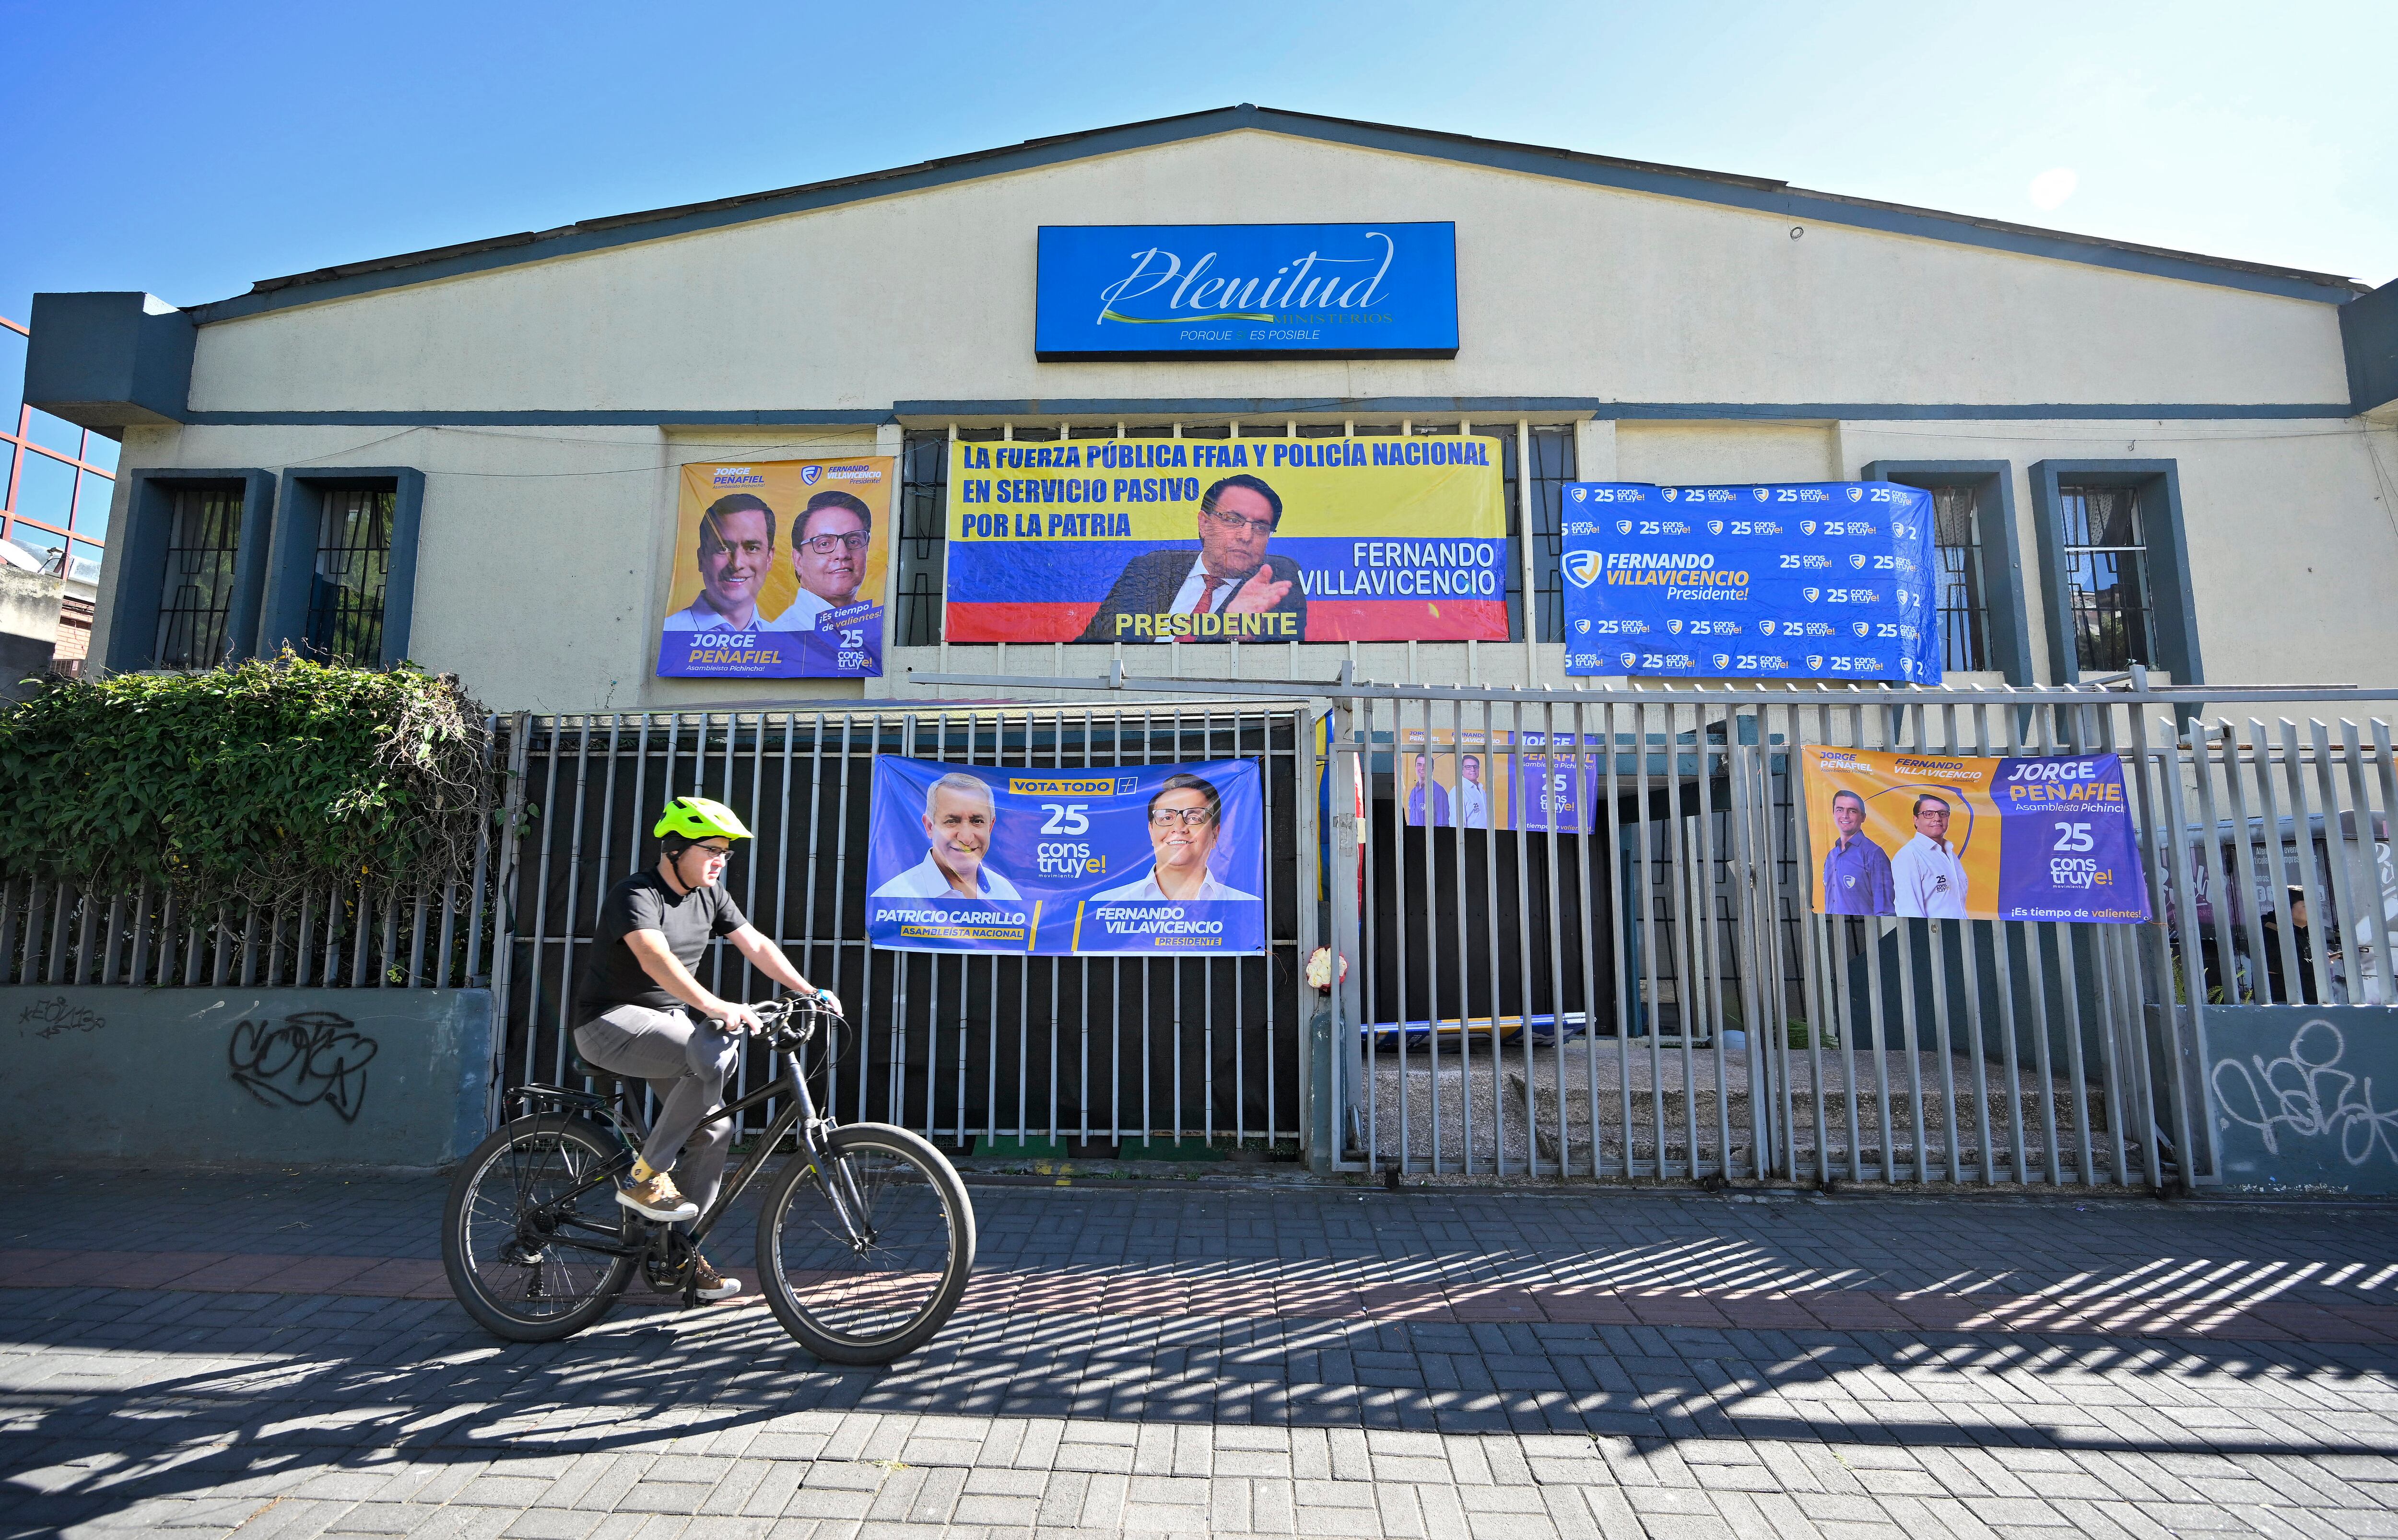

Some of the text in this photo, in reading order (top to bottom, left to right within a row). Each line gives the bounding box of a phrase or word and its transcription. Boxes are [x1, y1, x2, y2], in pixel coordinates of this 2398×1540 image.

[1096, 232, 1394, 325] Plenitud
[1272, 313, 1393, 325] MINISTERIOS
[1180, 330, 1233, 340] PORQUE
[1250, 330, 1265, 340] ES
[1269, 330, 1320, 340] POSIBLE
[964, 439, 1490, 469] LA FUERZA PÚBLICA FFAA Y POLICÍA NACIONAL
[714, 467, 751, 476] JORGE
[714, 475, 764, 484] PEÑAFIEL
[963, 477, 1199, 503] EN SERVICIO PASIVO
[1595, 489, 1614, 502] 25
[1685, 490, 1704, 502] 25
[1776, 489, 1798, 502] 25
[1870, 489, 1890, 502] 25
[1892, 490, 1907, 499] cons
[1617, 494, 1645, 502] truye!
[1708, 494, 1736, 502] truye!
[1800, 494, 1829, 502] truye!
[1892, 496, 1912, 506] truye!
[962, 513, 1131, 537] POR LA PATRIA
[1562, 523, 1568, 536] 5
[1572, 526, 1599, 535] truye!
[1640, 521, 1659, 534] 25
[1662, 526, 1691, 535] truye!
[1731, 522, 1751, 535] 25
[1754, 527, 1783, 536] truye!
[1824, 522, 1844, 535] 25
[1847, 527, 1876, 536] truye!
[1353, 543, 1494, 567] FERNANDO
[1607, 553, 1714, 569] FERNANDO
[1780, 555, 1800, 568] 25
[1895, 557, 1911, 565] cons
[1803, 560, 1832, 569] truye!
[1873, 555, 1894, 569] 25
[1896, 562, 1916, 572] truye!
[1297, 569, 1495, 595] VILLAVICENCIO
[1607, 570, 1749, 586] VILLAVICENCIO
[1667, 586, 1749, 600] Presidente!
[1827, 589, 1847, 603] 25
[1851, 595, 1879, 603] truye!
[819, 604, 869, 624] ¡Es tiempo
[822, 609, 882, 632] de valientes!
[1115, 612, 1298, 636] PRESIDENTE
[1599, 620, 1618, 633] 25
[1622, 625, 1650, 634] truye!
[1691, 621, 1710, 634] 25
[1783, 622, 1803, 636] 25
[1877, 624, 1897, 637] 25
[1714, 627, 1742, 635] truye!
[1807, 628, 1835, 637] truye!
[690, 634, 756, 647] JORGE
[840, 630, 863, 648] 25
[688, 647, 782, 664] PEÑAFIEL
[837, 651, 864, 659] cons
[1565, 654, 1572, 668] 5
[1643, 654, 1663, 668] 25
[837, 657, 872, 670] truye!
[1575, 659, 1603, 668] truye!
[1666, 660, 1695, 669] truye!
[1737, 655, 1757, 669] 25
[1760, 661, 1788, 670] truye!
[1831, 656, 1851, 671] 25
[1854, 663, 1883, 672] truye!
[1820, 752, 1857, 761] JORGE
[1821, 759, 1872, 771] PEÑAFIEL
[1895, 758, 1963, 770] FERNANDO
[1894, 766, 1982, 779] VILLAVICENCIO
[2007, 762, 2095, 781] JORGE
[1014, 782, 1109, 792] VOTA TODO
[2010, 780, 2124, 801] PEÑAFIE
[1540, 794, 1567, 803] cns
[1540, 801, 1575, 813] tye!
[2016, 803, 2126, 813] Asambleísta Pichinc!
[1040, 804, 1089, 835] 25
[2053, 822, 2094, 852] 25
[1037, 842, 1090, 858] cons
[1037, 855, 1106, 878] truye!
[2050, 858, 2097, 872] cons
[1936, 875, 1946, 884] 25
[2050, 869, 2113, 889] truye!
[875, 909, 1025, 925] PATRICIO CARRILLO
[1095, 908, 1185, 920] FERNANDO
[2011, 907, 2141, 918] ¡Es tiempo de valientes!
[903, 926, 1023, 938] ASAMBLEÍSTA NACIONAL
[1105, 921, 1223, 933] VILLAVICENCIO
